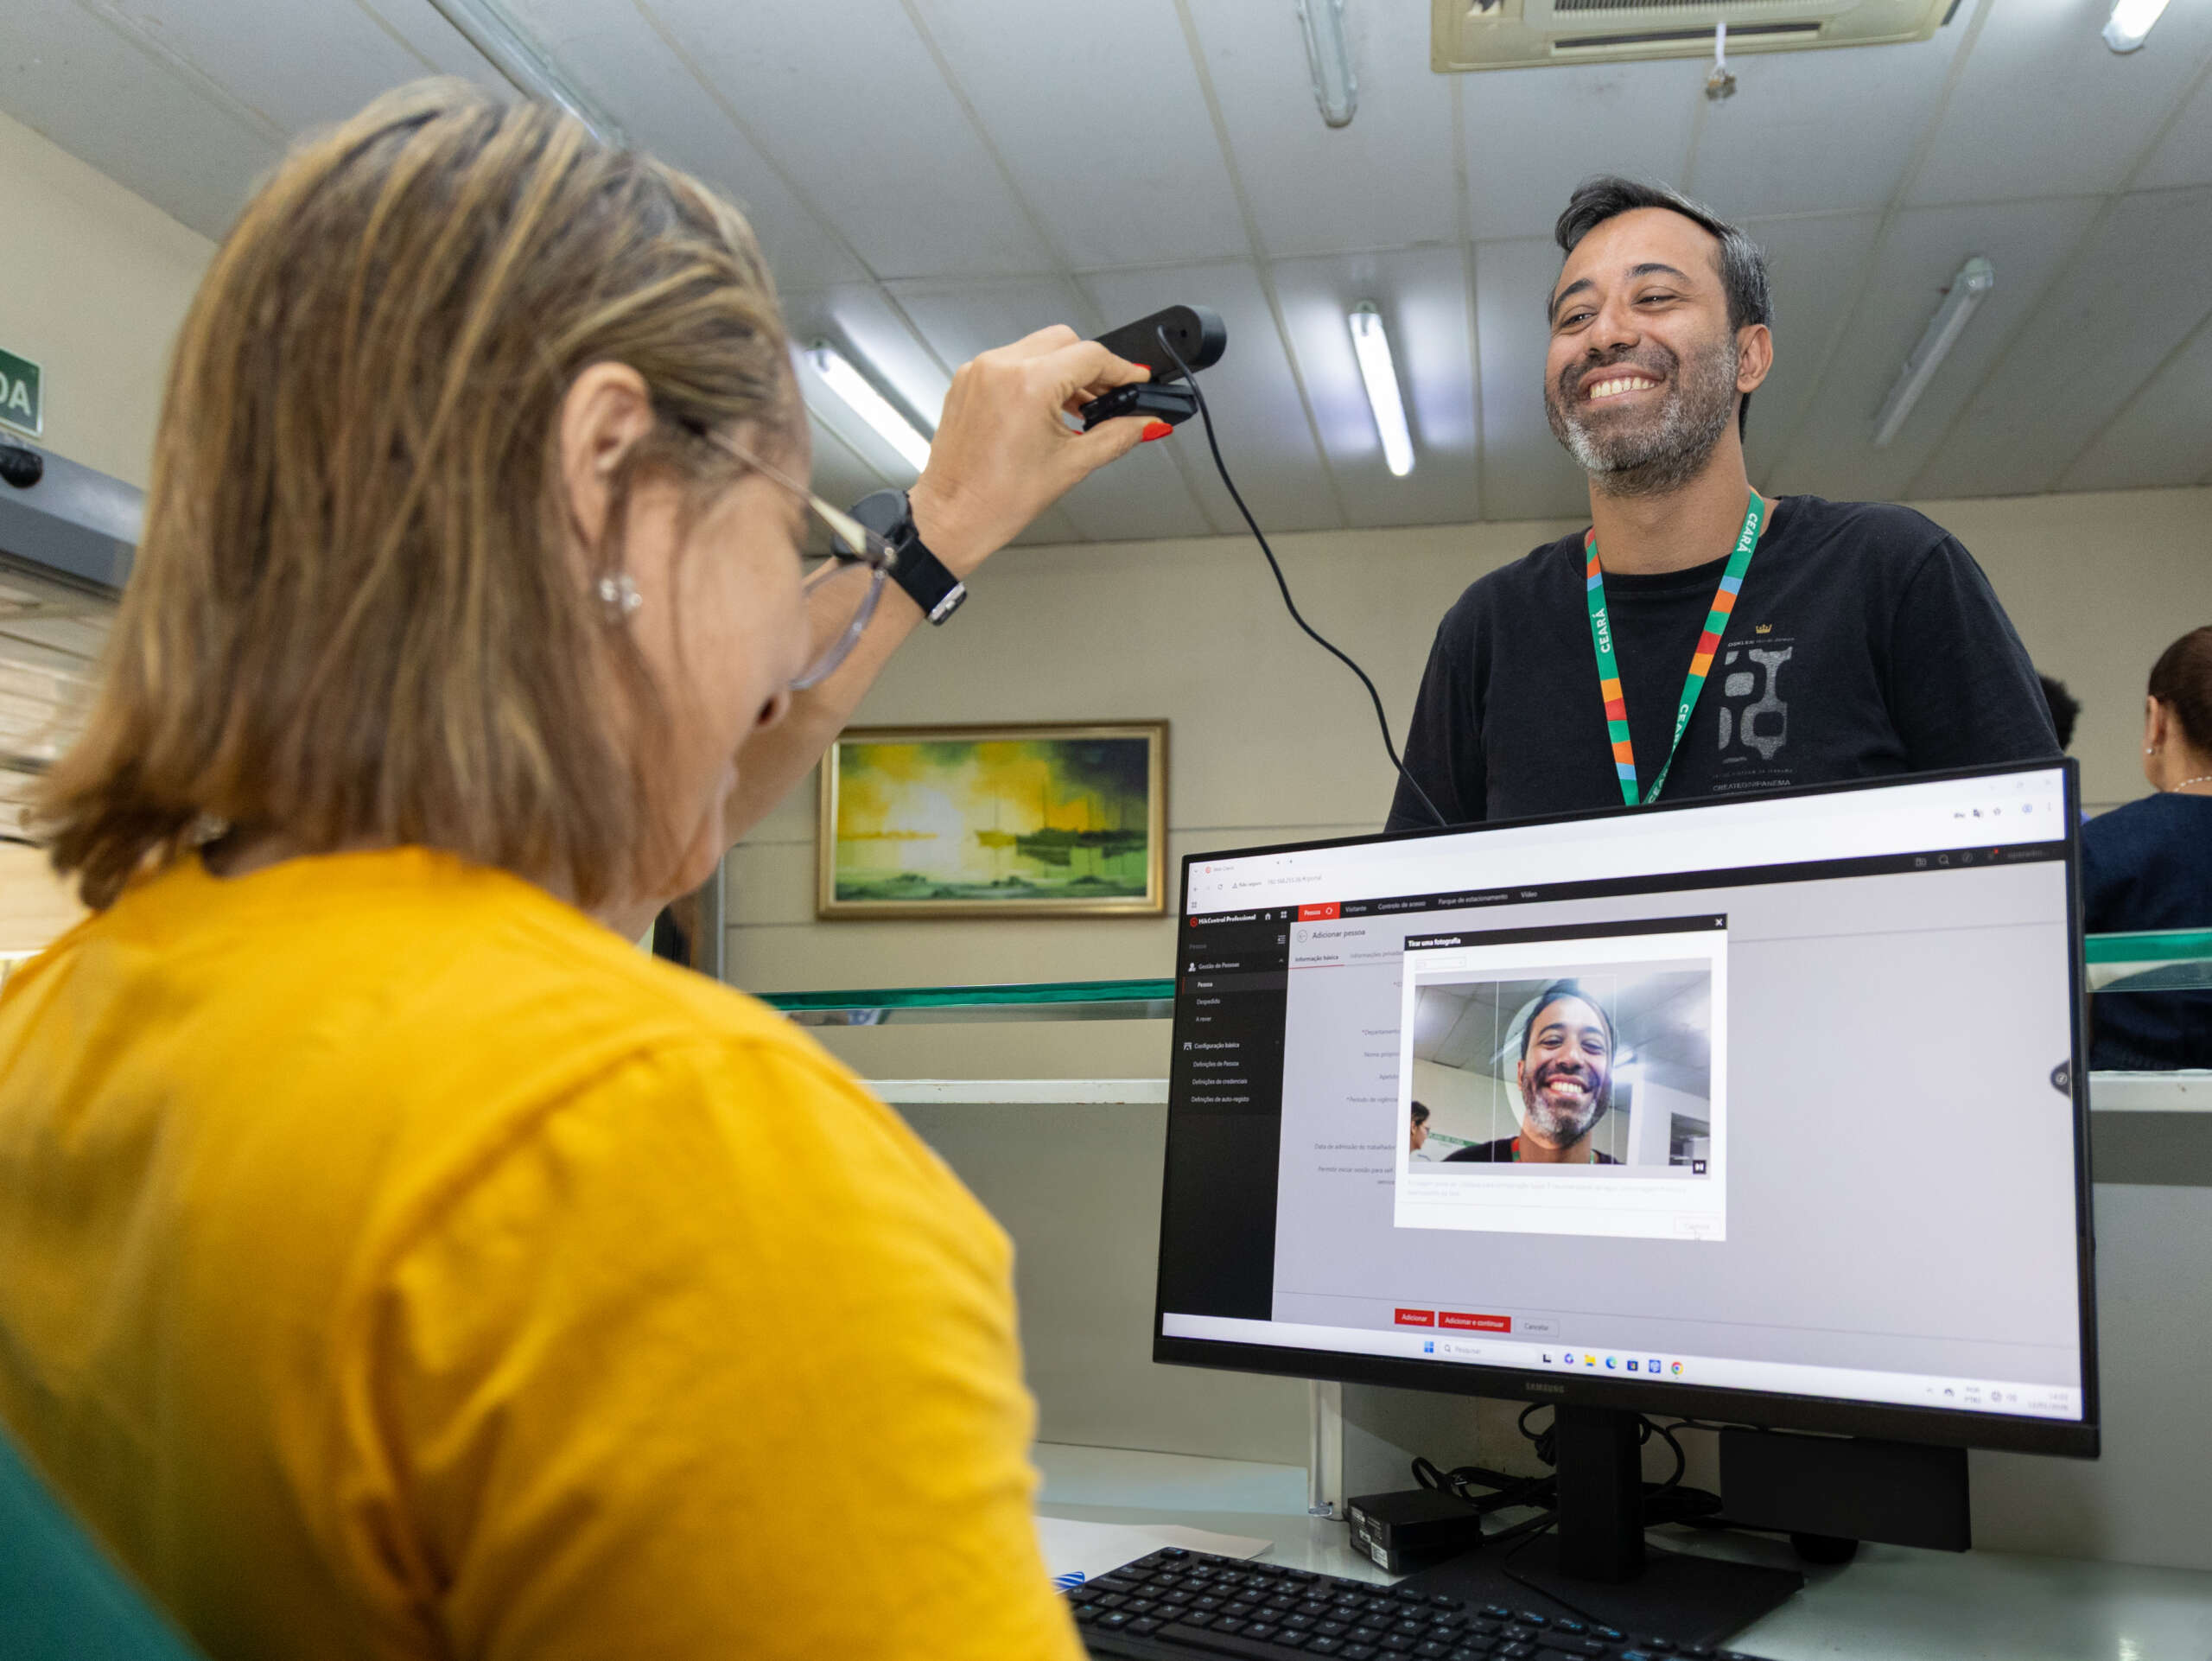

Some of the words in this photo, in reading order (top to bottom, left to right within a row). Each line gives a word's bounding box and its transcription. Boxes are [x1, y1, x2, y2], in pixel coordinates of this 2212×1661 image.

[1737, 512, 1759, 554] CEARÁ
[1592, 608, 1611, 653] CEARÁ
[1438, 897, 1456, 906] Parque
[1465, 894, 1509, 903] estacionamento
[1345, 905, 1367, 913] Visitante
[1198, 915, 1226, 926] HikCentral
[1227, 913, 1256, 923] Professional
[1312, 931, 1341, 939] Adicionar
[1343, 929, 1365, 938] pessoa
[1434, 936, 1461, 947] fotografia
[1402, 1313, 1427, 1322] Adicionar
[1445, 1316, 1471, 1326] Adicionar
[1478, 1320, 1503, 1328] continuar
